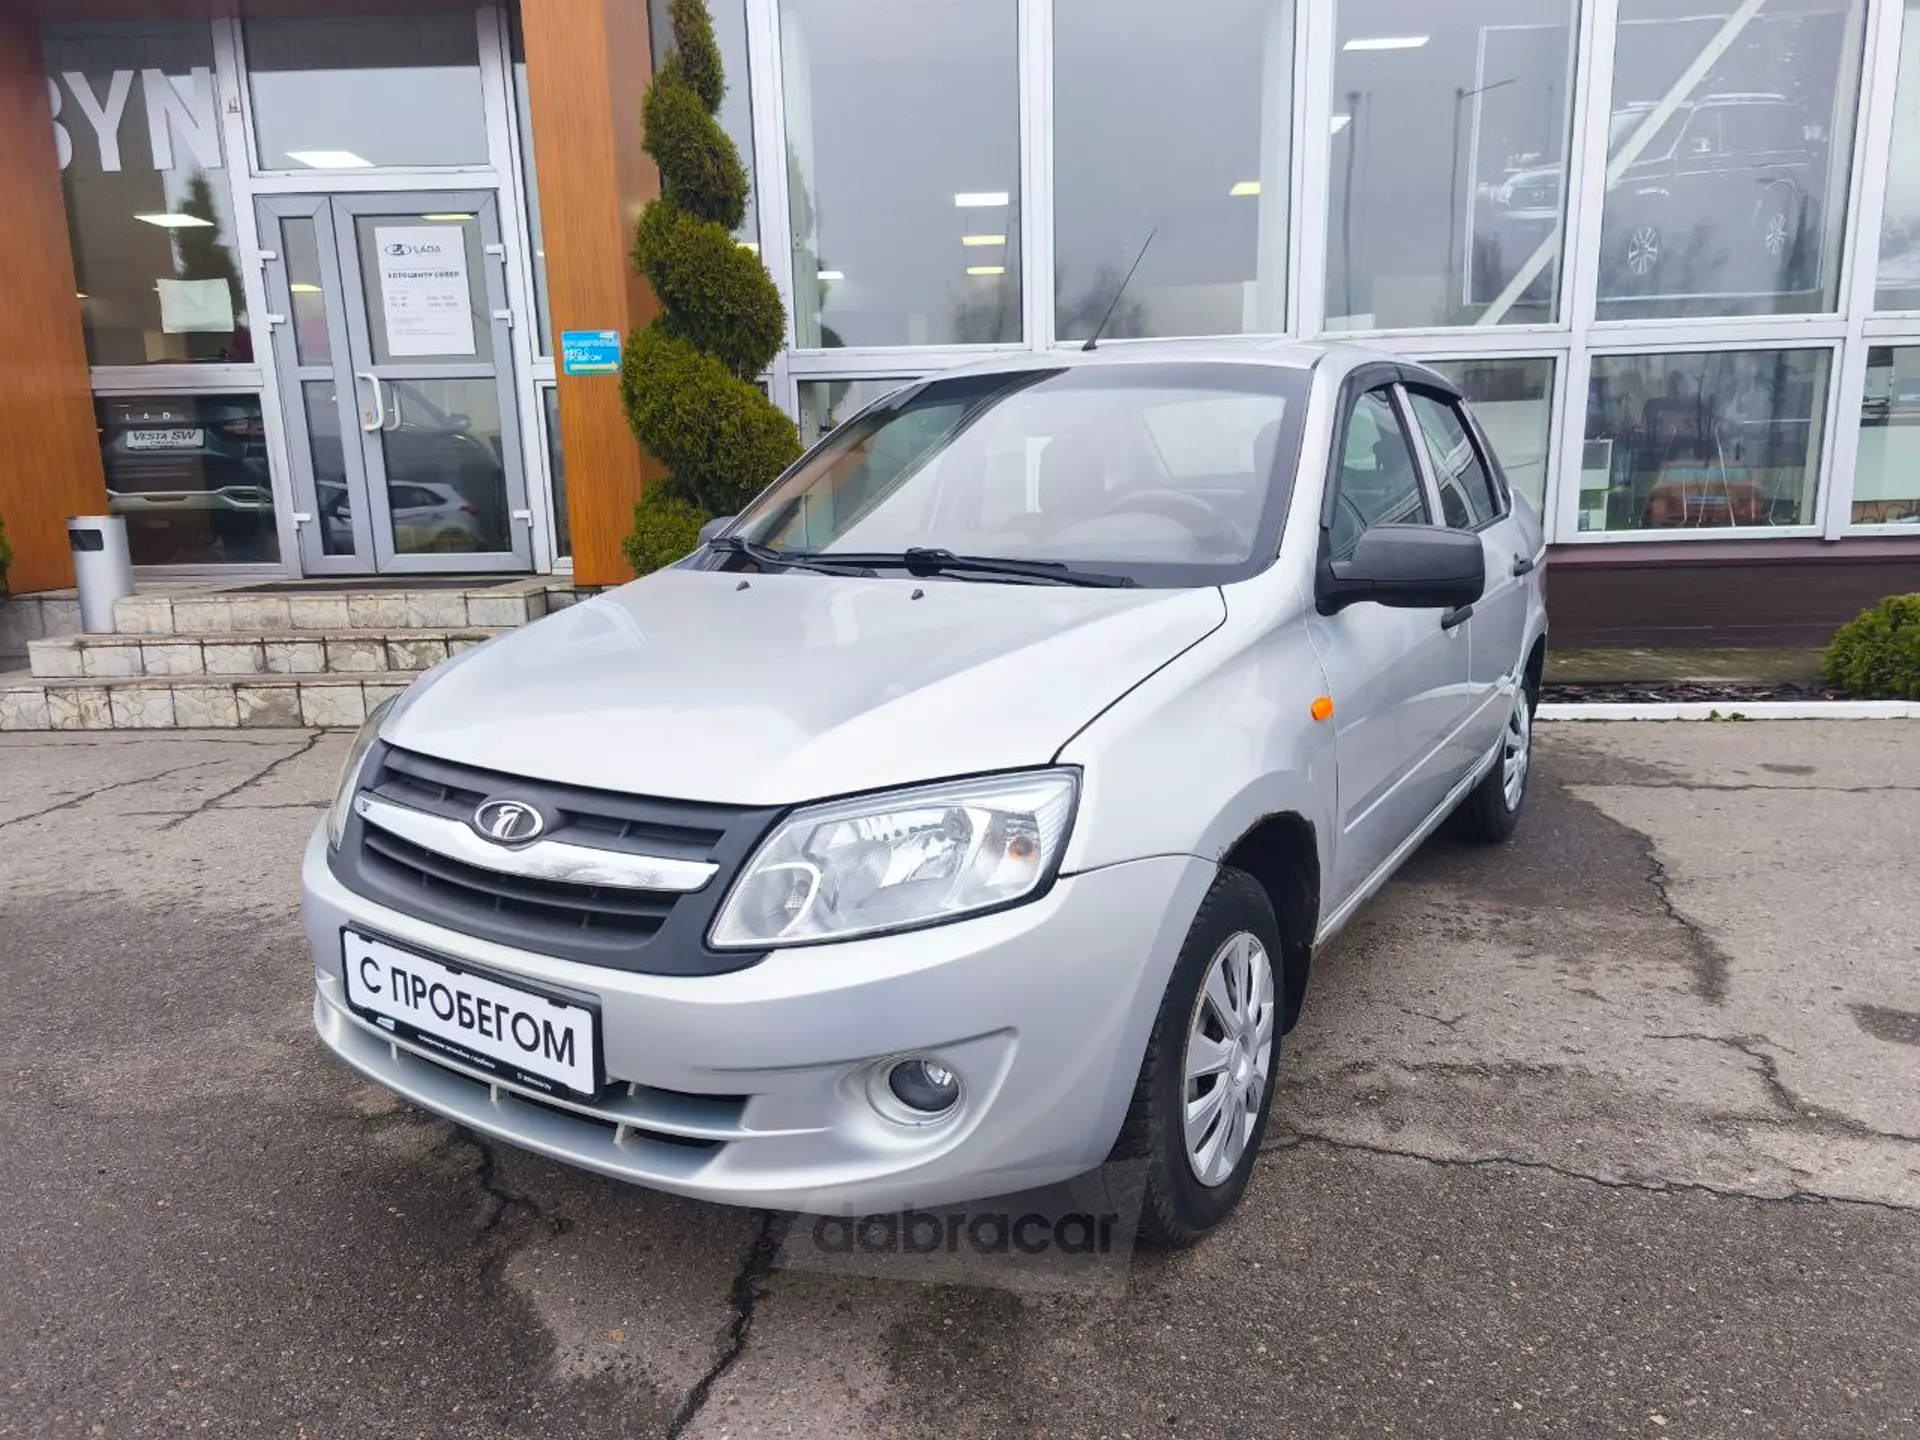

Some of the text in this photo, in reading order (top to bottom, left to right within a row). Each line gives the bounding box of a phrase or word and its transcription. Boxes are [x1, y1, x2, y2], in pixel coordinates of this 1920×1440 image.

[133, 431, 196, 441] VESTA SW
[360, 956, 382, 994] С
[391, 966, 576, 1068] ПРОБЕГОМ
